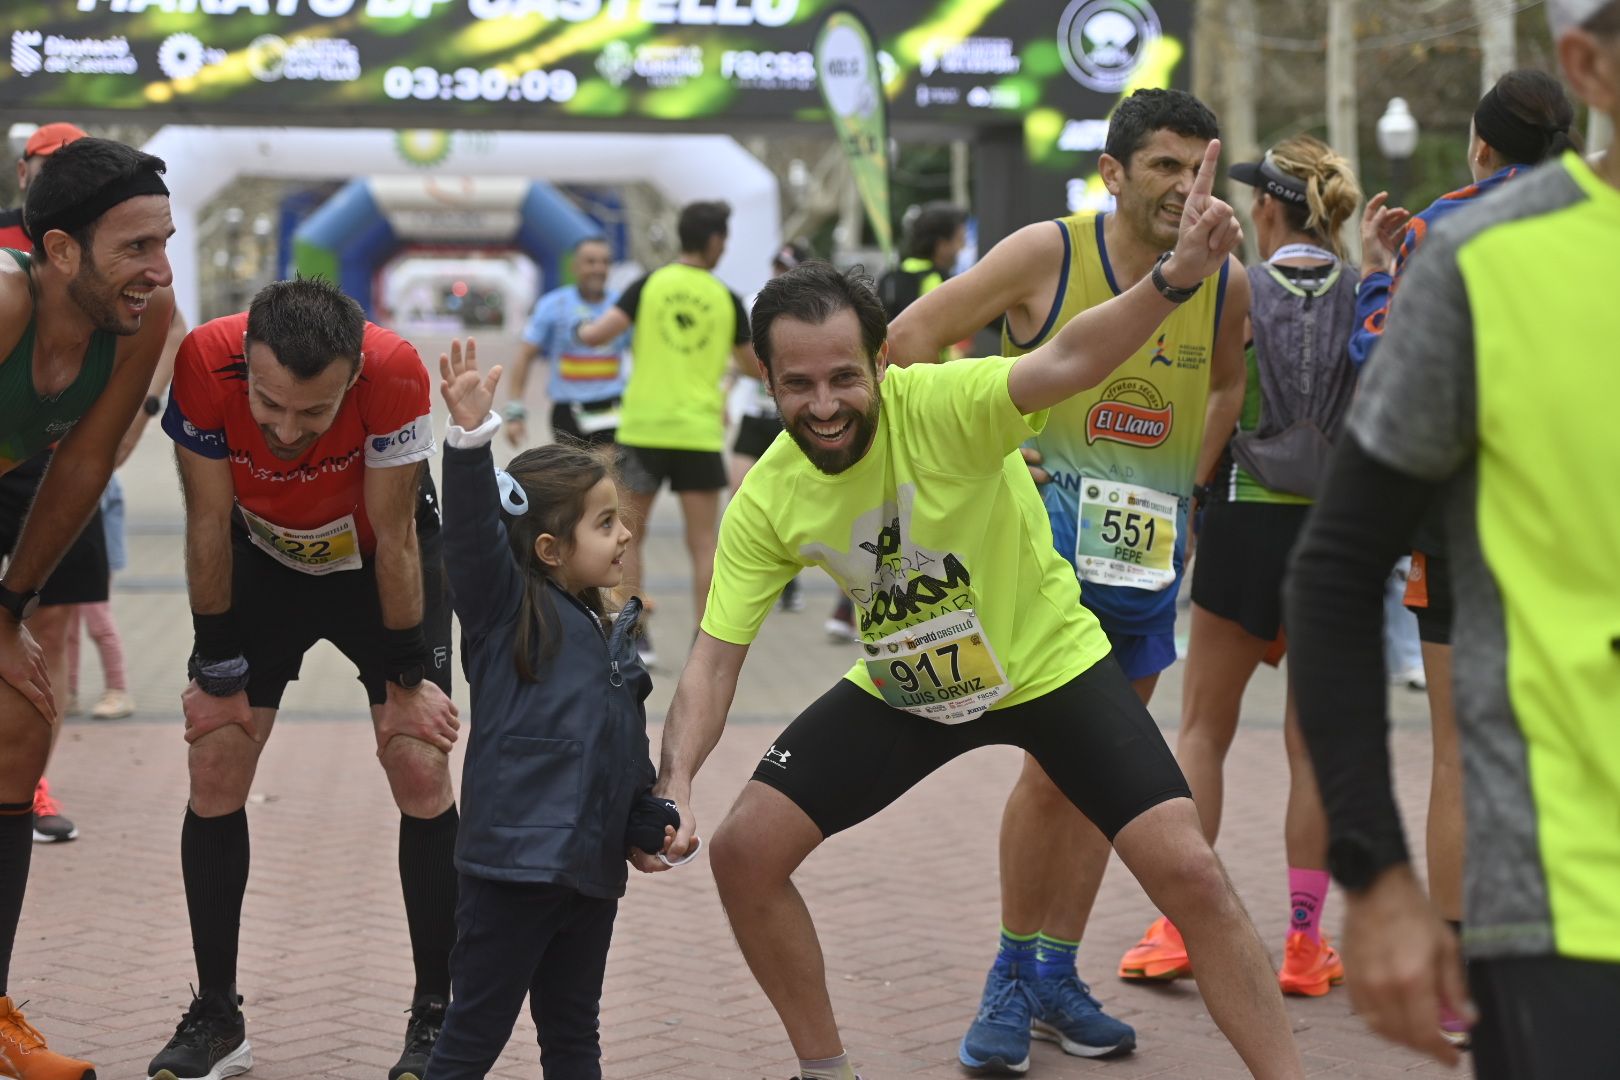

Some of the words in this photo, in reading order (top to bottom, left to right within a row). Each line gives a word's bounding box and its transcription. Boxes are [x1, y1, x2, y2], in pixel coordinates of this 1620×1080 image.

[383, 67, 578, 102] 03:30:09
[1095, 410, 1113, 429] El
[1114, 412, 1165, 437] Llano
[1101, 508, 1155, 552] 551
[1115, 546, 1143, 564] PEPE
[907, 630, 938, 650] marató
[936, 618, 974, 640] CASTELLÓ
[890, 643, 962, 693] 917
[901, 690, 936, 707] LUIS
[937, 677, 985, 700] ORVIZ
